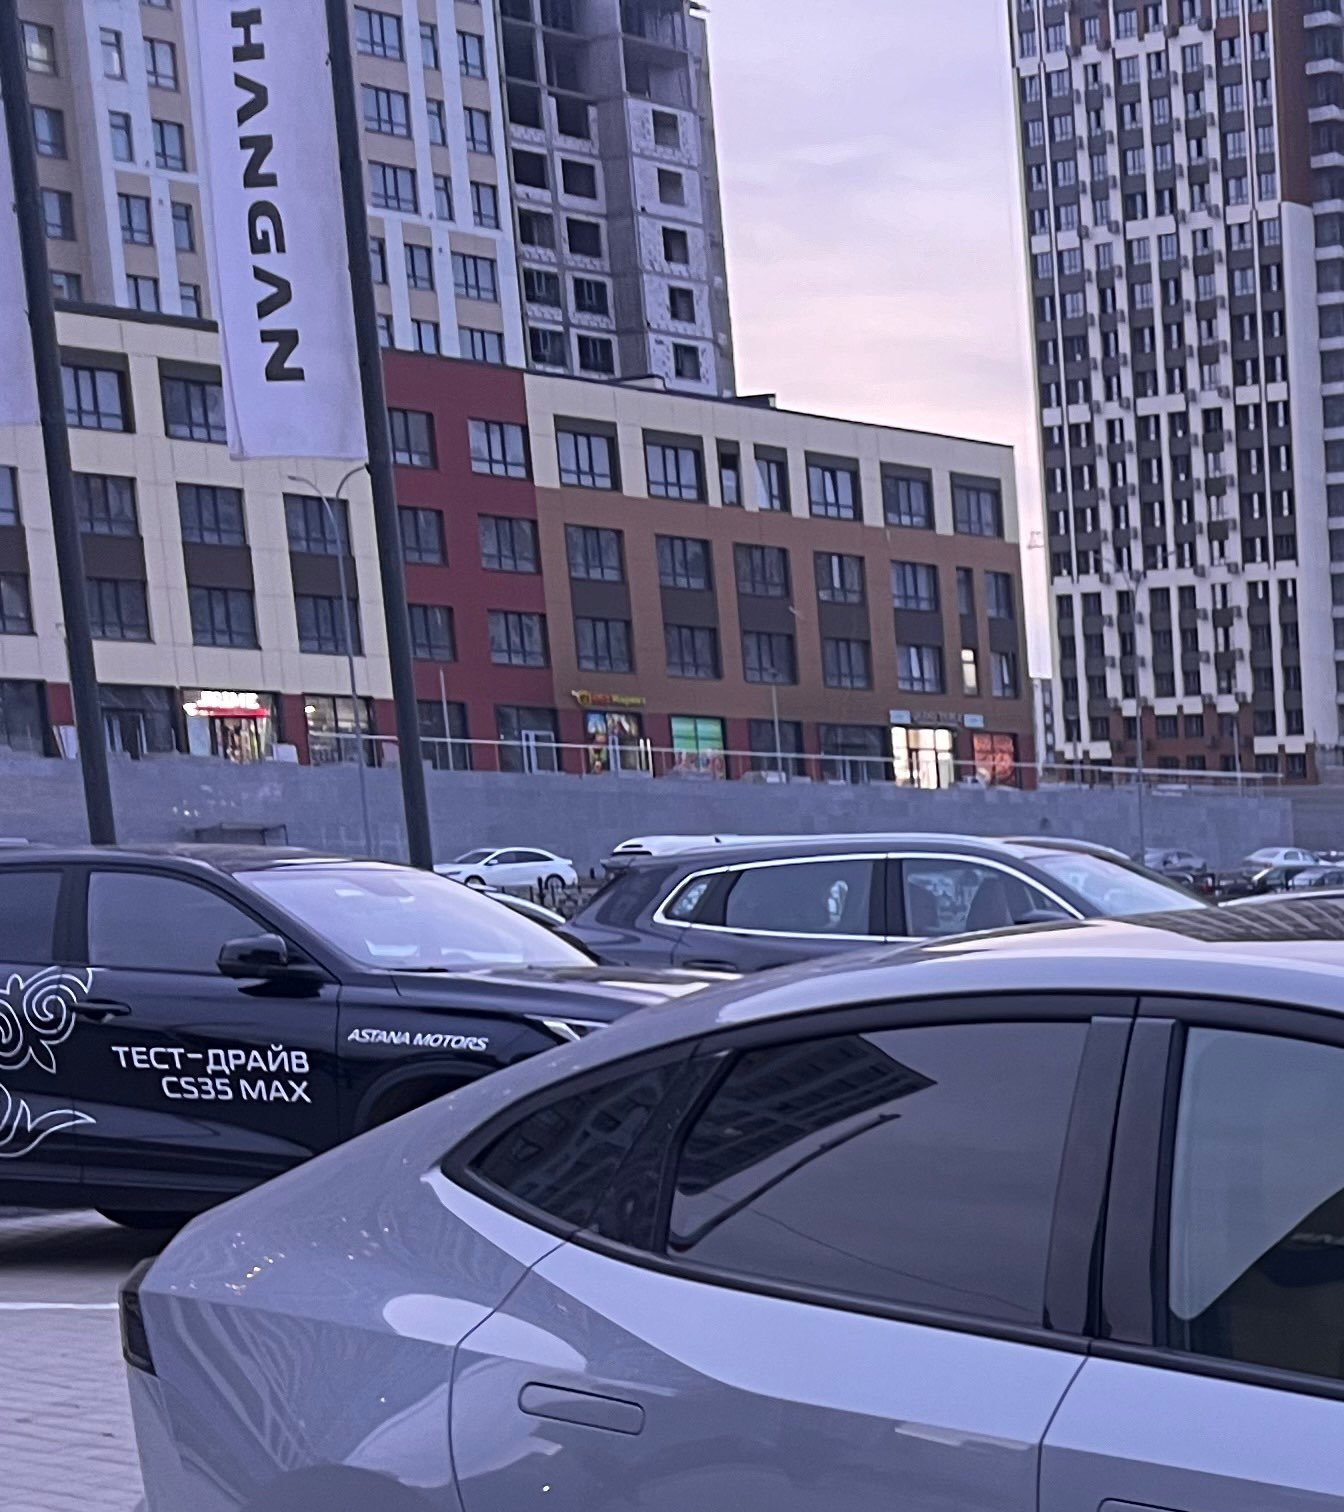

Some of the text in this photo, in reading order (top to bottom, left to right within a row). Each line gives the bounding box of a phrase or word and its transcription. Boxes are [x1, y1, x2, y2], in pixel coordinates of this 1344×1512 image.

[348, 1028, 489, 1051] ASTANA MOTORS
[111, 1044, 310, 1075] ТЕСТ-ДРАЙВ
[161, 1076, 313, 1104] CS35 MAX
